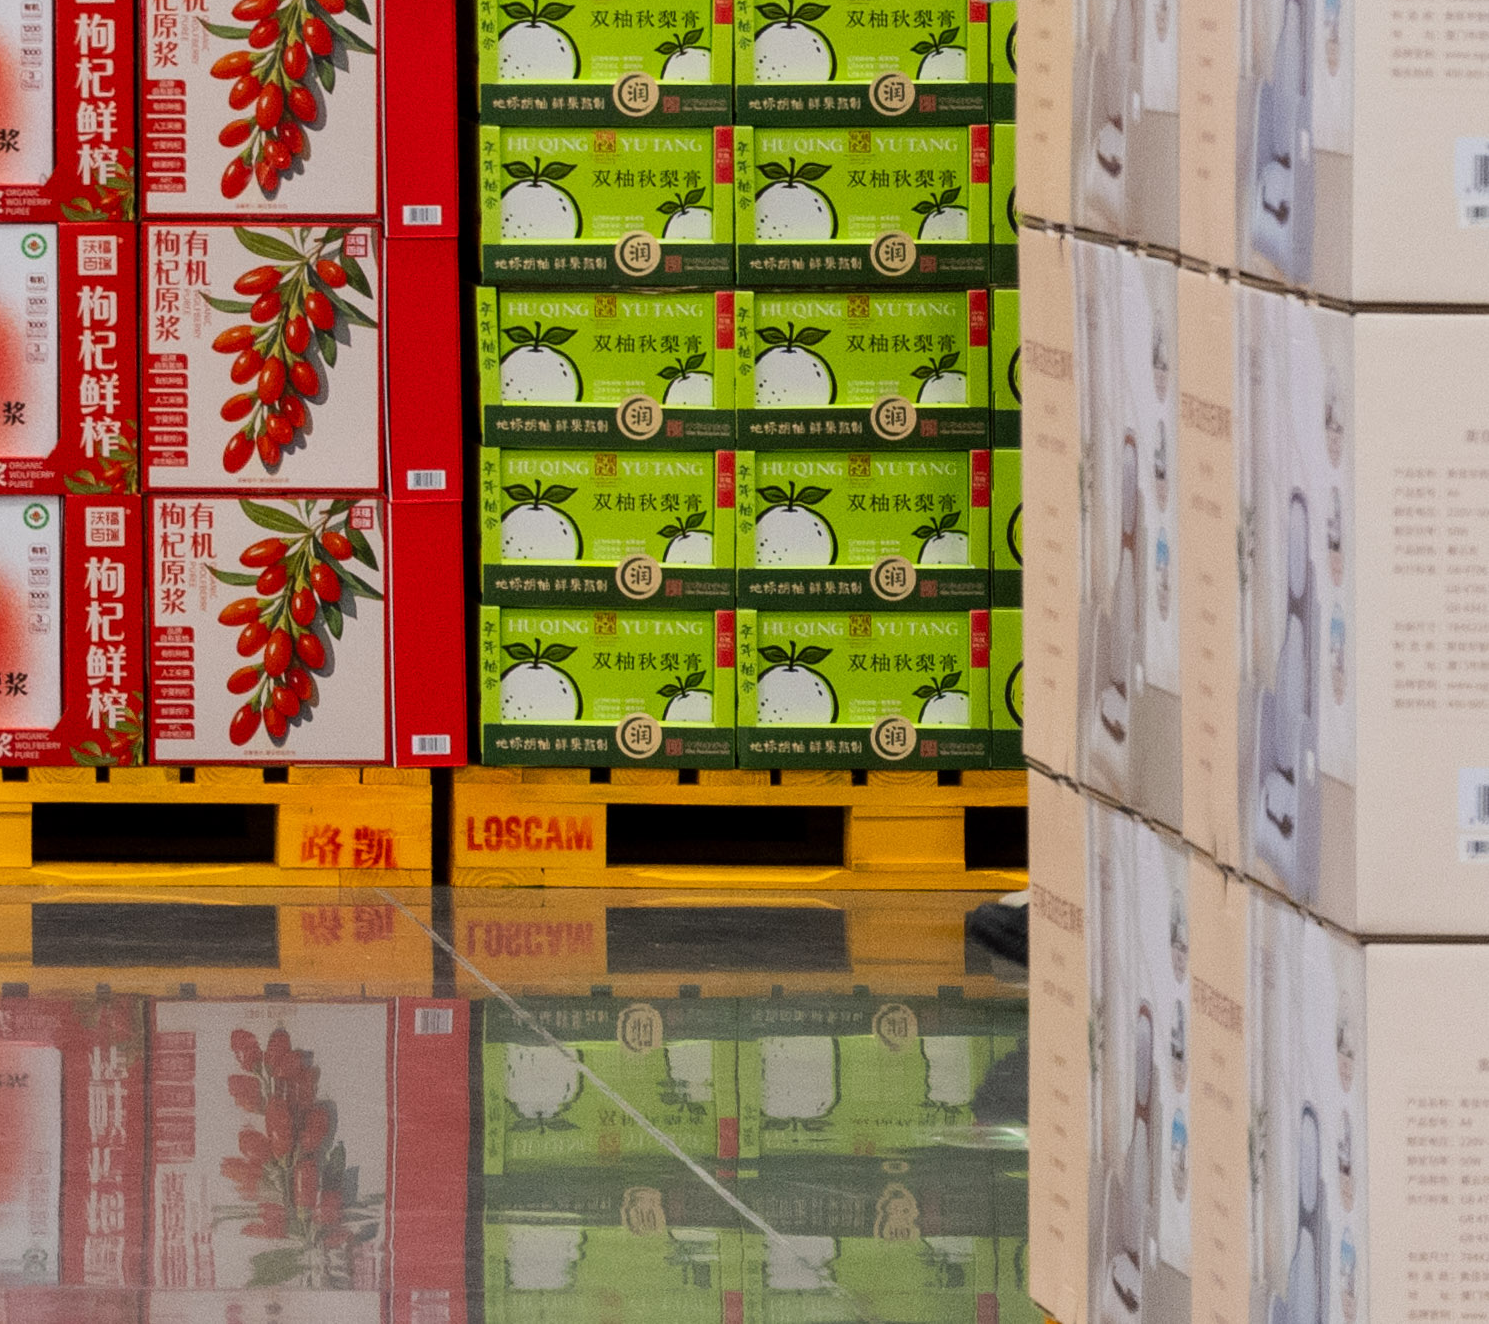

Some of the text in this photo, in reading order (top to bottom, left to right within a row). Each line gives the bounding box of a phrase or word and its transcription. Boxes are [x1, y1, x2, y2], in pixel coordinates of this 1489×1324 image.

[77, 285, 121, 458] 枸杞鲜榨
[593, 649, 703, 673] 双柚秋梨膏
[301, 822, 397, 870] 路凯
[466, 815, 595, 853] LOSCAM
